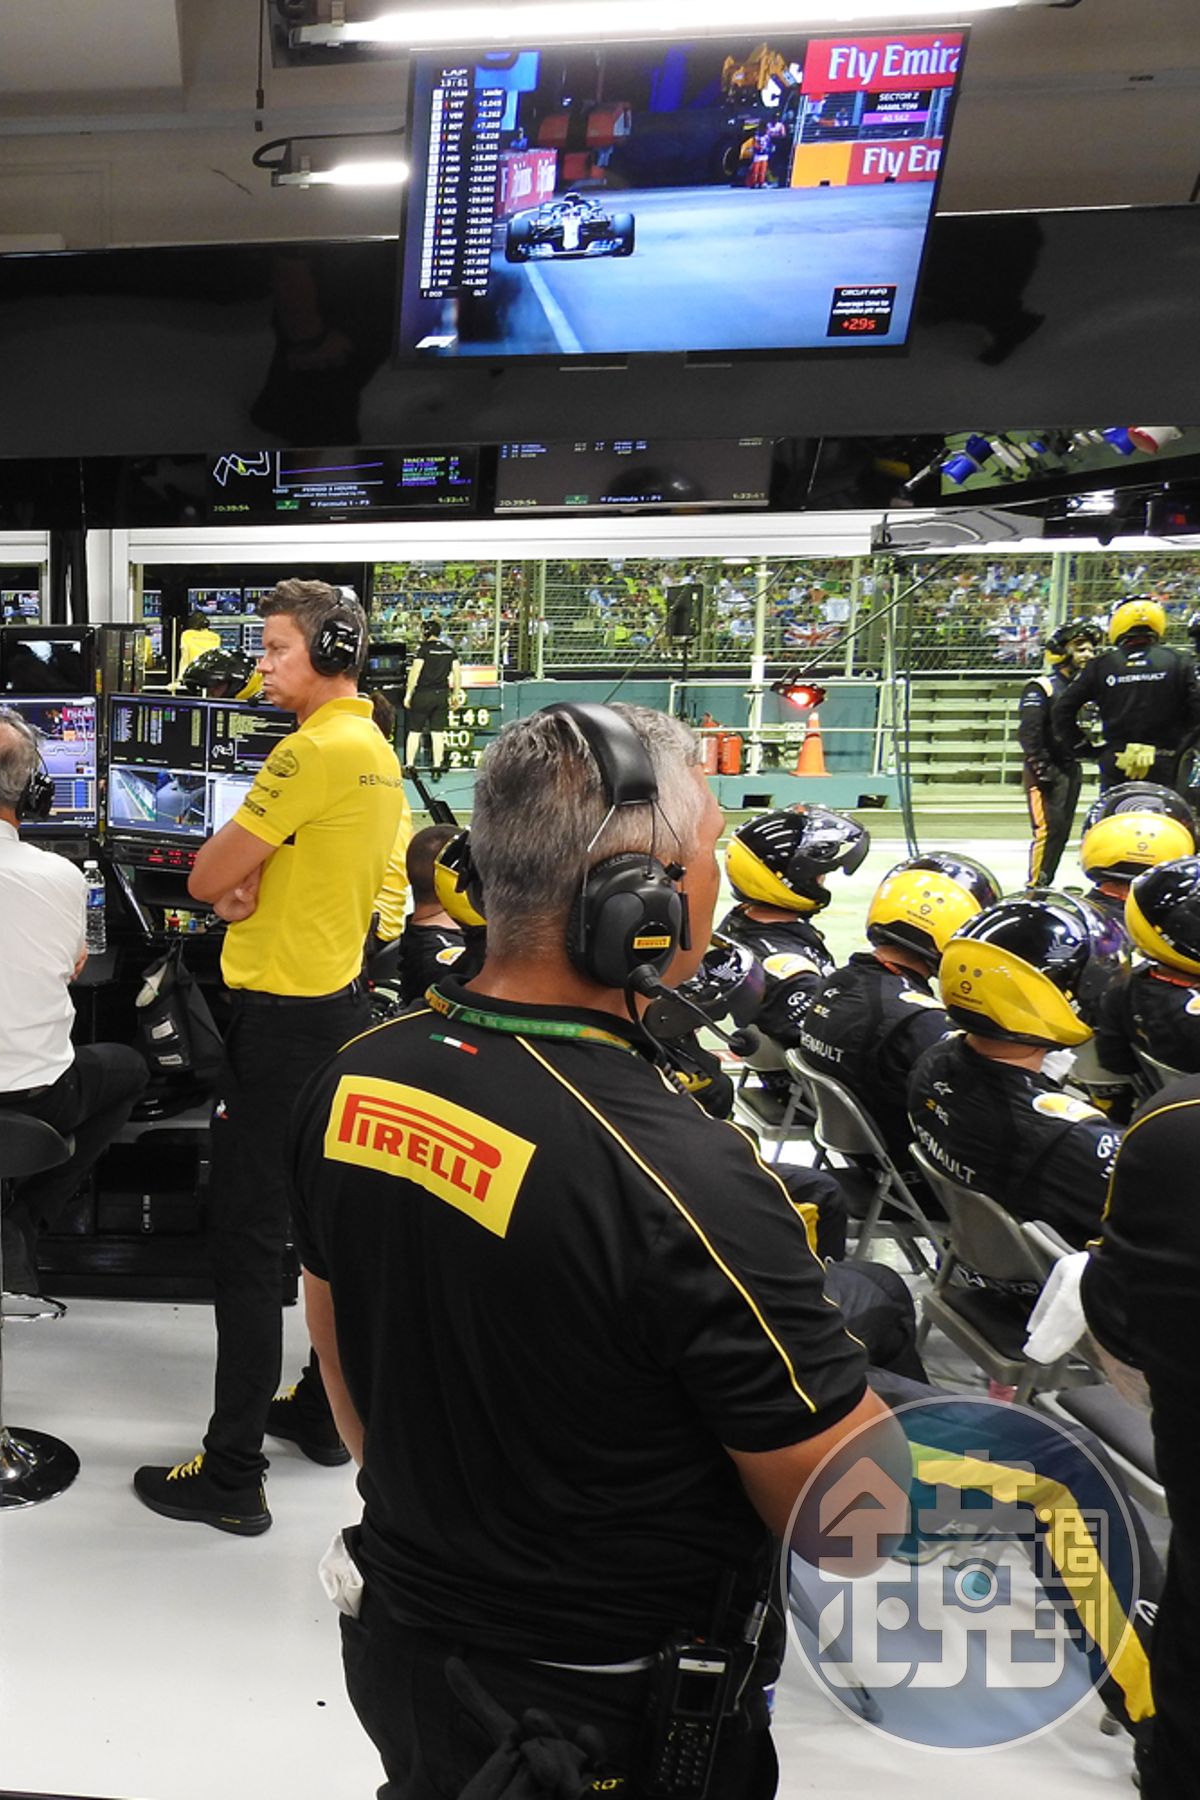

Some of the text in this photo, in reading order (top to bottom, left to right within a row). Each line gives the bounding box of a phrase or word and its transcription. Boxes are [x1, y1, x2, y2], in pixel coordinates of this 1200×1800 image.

[828, 46, 879, 85] Fly
[442, 69, 468, 77] LAP
[879, 92, 912, 102] SECTOR
[876, 103, 919, 111] HAMILTON
[862, 147, 905, 178] Fly
[841, 288, 888, 296] CIRCUIT INFO
[842, 318, 876, 331] +29s
[337, 1093, 502, 1203] PIRELLI
